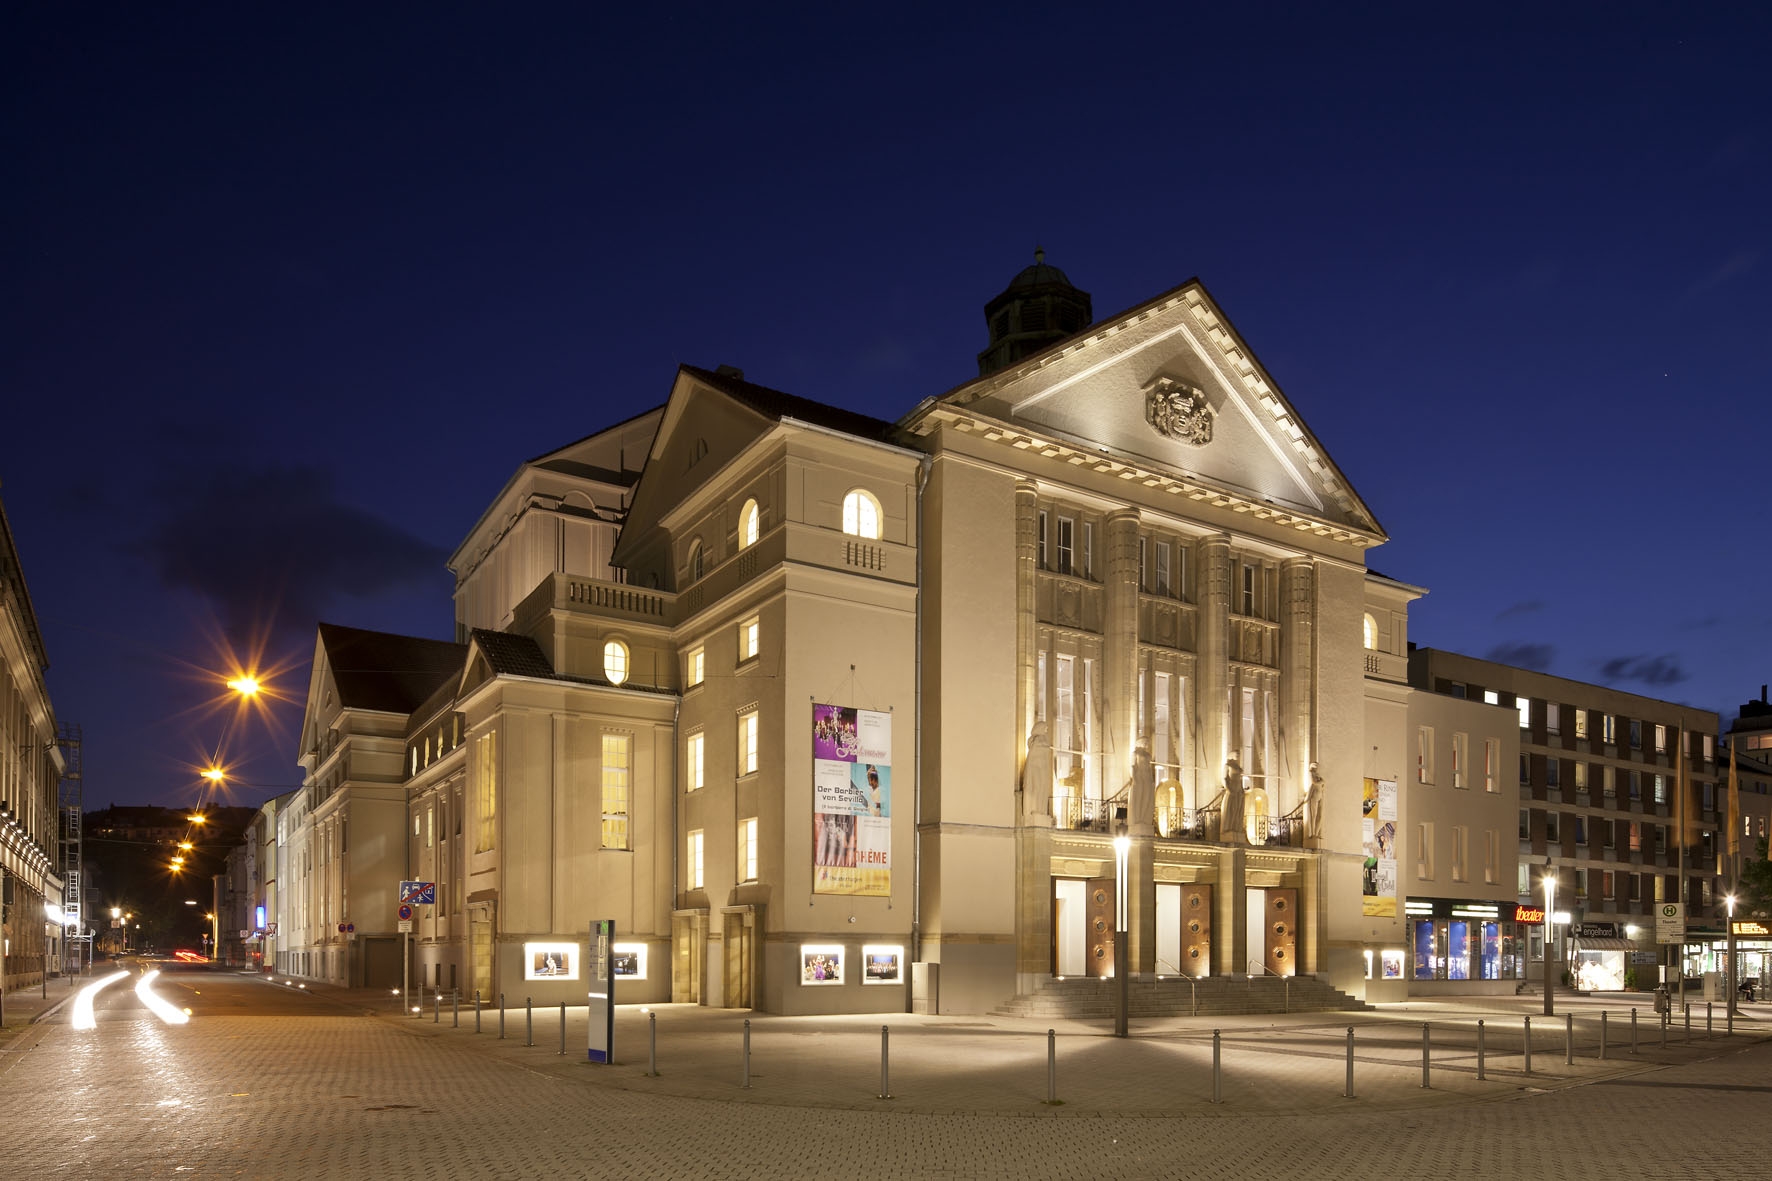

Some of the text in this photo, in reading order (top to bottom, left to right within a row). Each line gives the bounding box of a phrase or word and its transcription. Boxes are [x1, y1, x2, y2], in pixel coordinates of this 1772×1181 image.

[834, 787, 864, 796] Barbier
[838, 795, 863, 803] Sevilla
[853, 848, 887, 864] OHÈME
[1516, 905, 1544, 922] theater
[1583, 928, 1613, 938] engelhard
